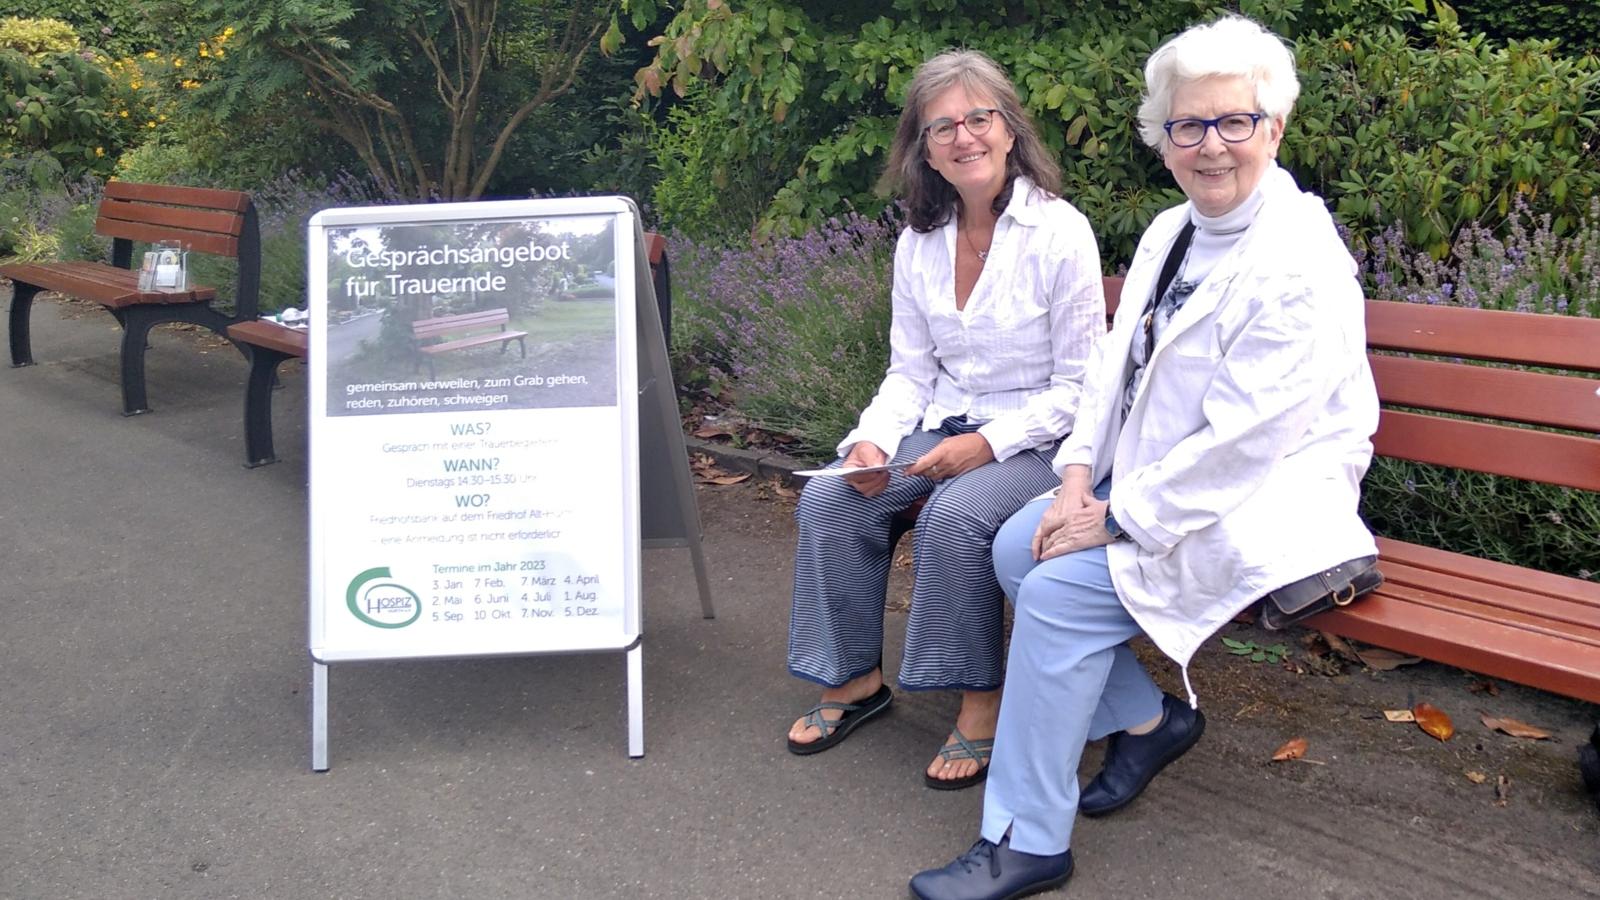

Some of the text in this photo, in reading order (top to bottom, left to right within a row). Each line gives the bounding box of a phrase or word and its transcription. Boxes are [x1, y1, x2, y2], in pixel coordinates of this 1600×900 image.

[346, 241, 571, 271] Gesprächsangebot
[346, 271, 506, 297] für Trauernde
[346, 373, 589, 395] gemeinsam verweilen, zum Grab gehen,
[346, 392, 509, 409] reden, zuhören, schweigen
[450, 422, 492, 436] WAS?
[443, 457, 500, 472] WANN?
[406, 475, 455, 488] Dienstags
[455, 493, 491, 508] WO?
[460, 512, 485, 522] dem
[487, 509, 527, 521] Friedhof
[433, 559, 546, 575] Termine im Jahr 2023
[576, 573, 600, 586] April
